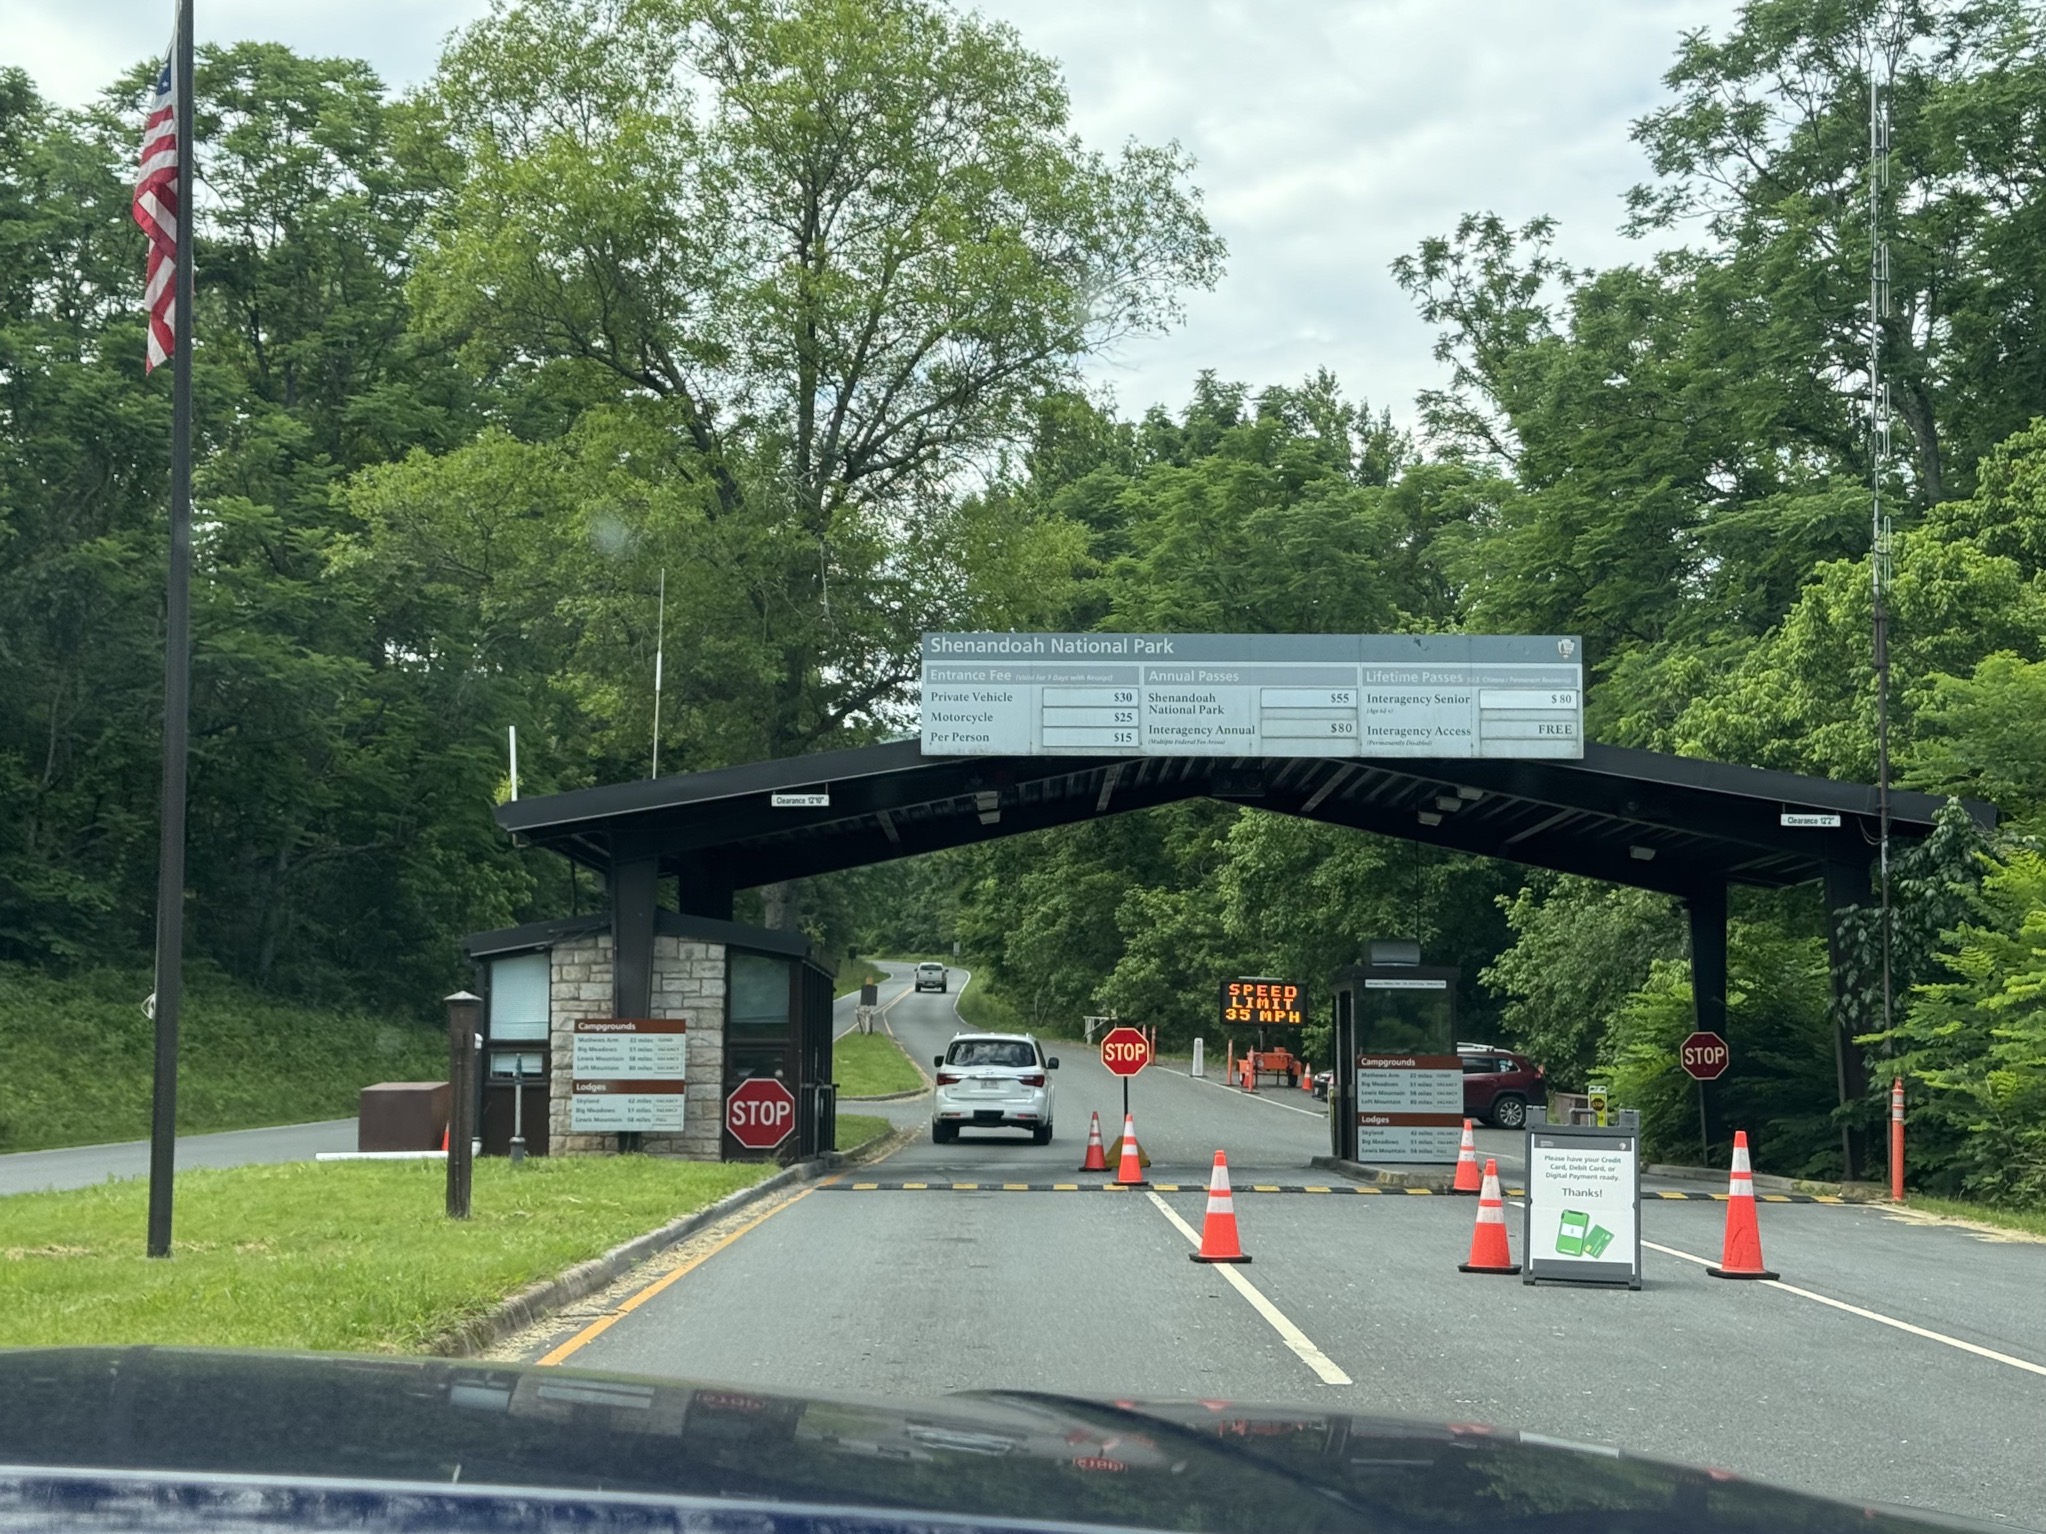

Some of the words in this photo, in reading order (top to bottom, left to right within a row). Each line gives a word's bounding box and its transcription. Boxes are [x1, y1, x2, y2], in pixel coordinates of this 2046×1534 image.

[930, 637, 1044, 654] Shenandoah
[1050, 637, 1128, 654] National
[1134, 638, 1174, 654] Park
[930, 669, 986, 682] Entrance
[990, 669, 1012, 682] Fee
[1149, 670, 1195, 682] Annual
[1198, 670, 1239, 683] Passes
[1366, 671, 1418, 683] Lifetime
[1422, 671, 1463, 684] Passes
[930, 692, 970, 703] Private
[972, 692, 1013, 703] Vehicle
[1114, 691, 1133, 704] $30
[1148, 692, 1216, 703] Shenandoah
[1330, 692, 1350, 704] $55
[1367, 693, 1432, 707] Interagency
[1434, 693, 1471, 704] Senior
[1148, 704, 1196, 715] National
[1199, 704, 1225, 715] Park
[930, 711, 994, 724] Motorcycle
[1114, 711, 1133, 724] $25
[1148, 724, 1213, 738] Interagency
[1215, 724, 1256, 735] Annual
[1330, 723, 1353, 734] $80
[1367, 725, 1432, 739] Interagency
[1434, 725, 1472, 736] Access
[1538, 724, 1573, 735] FREE
[930, 732, 950, 743] Per
[952, 732, 990, 743] Person
[1114, 731, 1133, 744] $15
[776, 796, 806, 805] Clearance
[1787, 816, 1818, 825] Clearance
[1228, 983, 1298, 998] SPEED
[1232, 996, 1294, 1010] LIMIT
[1225, 1008, 1251, 1021] 35
[1259, 1010, 1301, 1023] MPH
[578, 1021, 636, 1032] Campgrounds
[1104, 1042, 1146, 1062] STOP
[1684, 1046, 1725, 1066] STOP
[1361, 1057, 1416, 1068] Campgrounds
[576, 1082, 607, 1092] Lodges
[731, 1100, 791, 1126] STOP
[1361, 1115, 1390, 1125] Lodges
[1550, 1163, 1568, 1171] Card,
[1545, 1172, 1567, 1180] Digital
[1568, 1173, 1598, 1181] Payment
[1562, 1187, 1603, 1198] Thanks!
